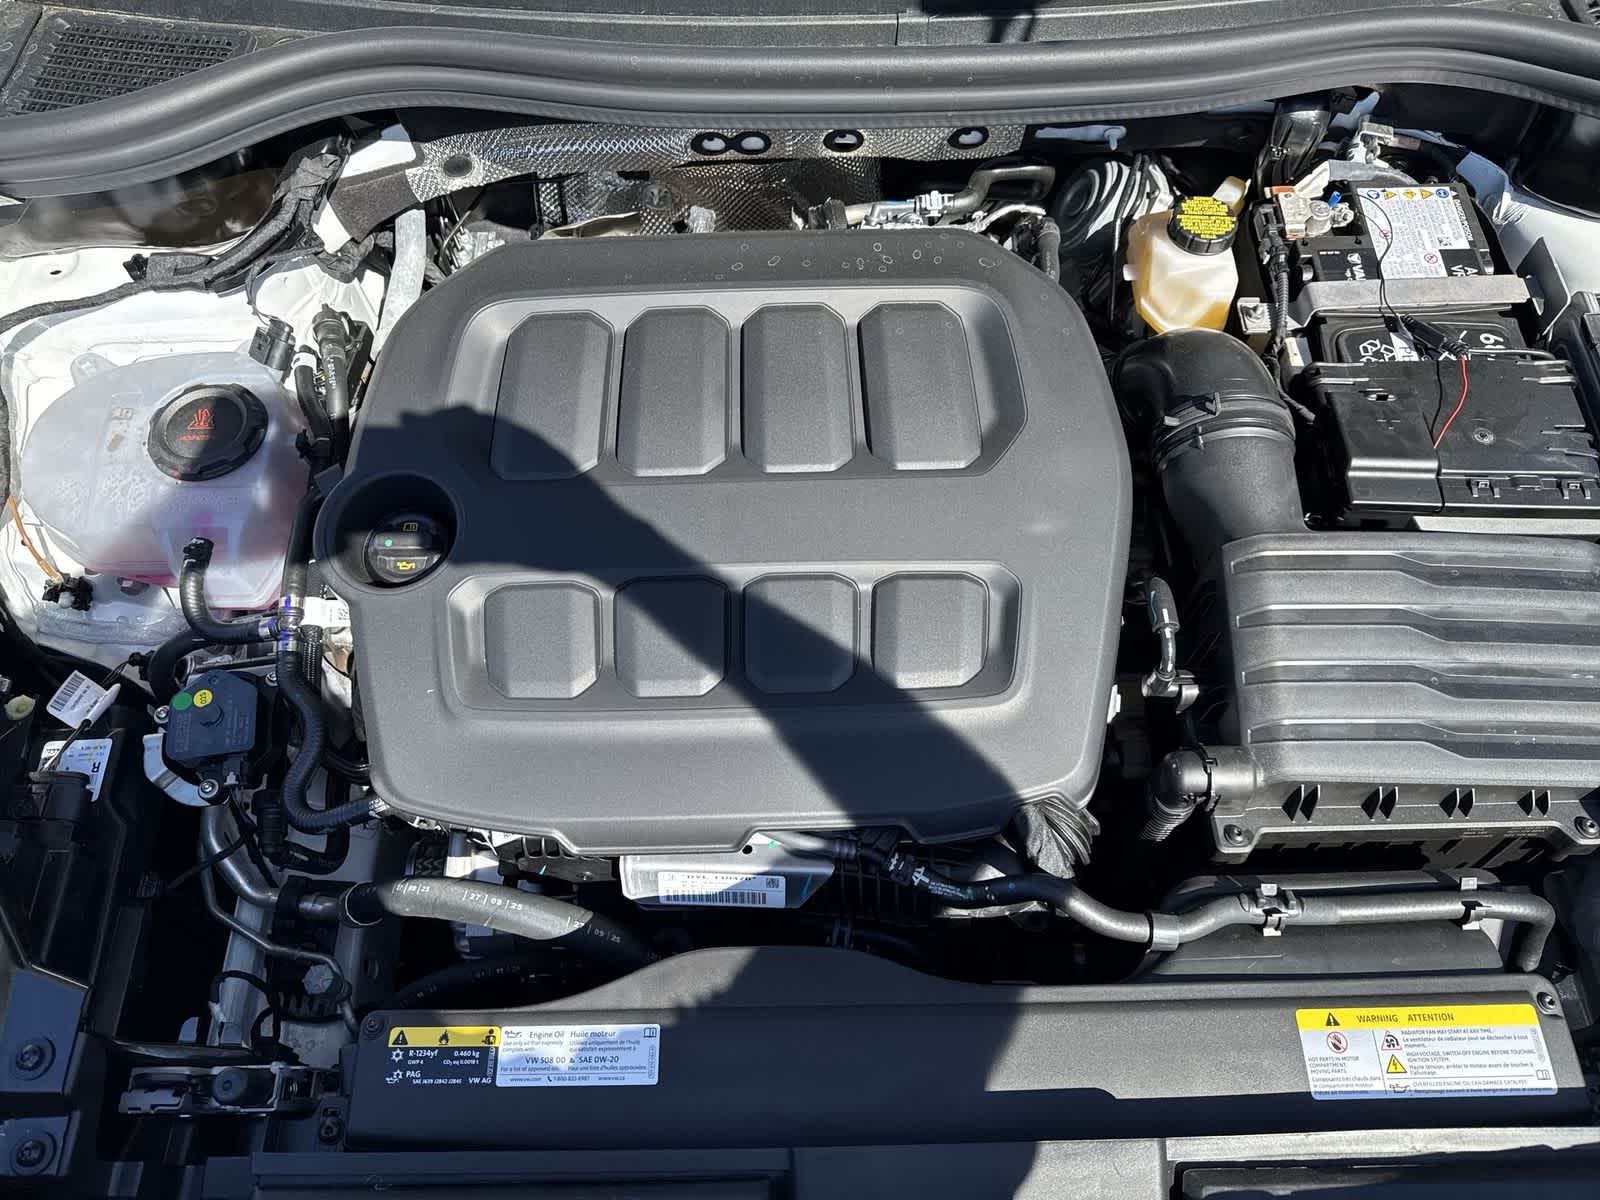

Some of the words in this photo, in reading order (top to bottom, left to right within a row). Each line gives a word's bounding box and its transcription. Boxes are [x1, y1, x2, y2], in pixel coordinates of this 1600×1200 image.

[1356, 1014, 1399, 1023] WARNING
[1408, 1013, 1454, 1022] ATTENTION
[530, 1031, 552, 1040] Engine
